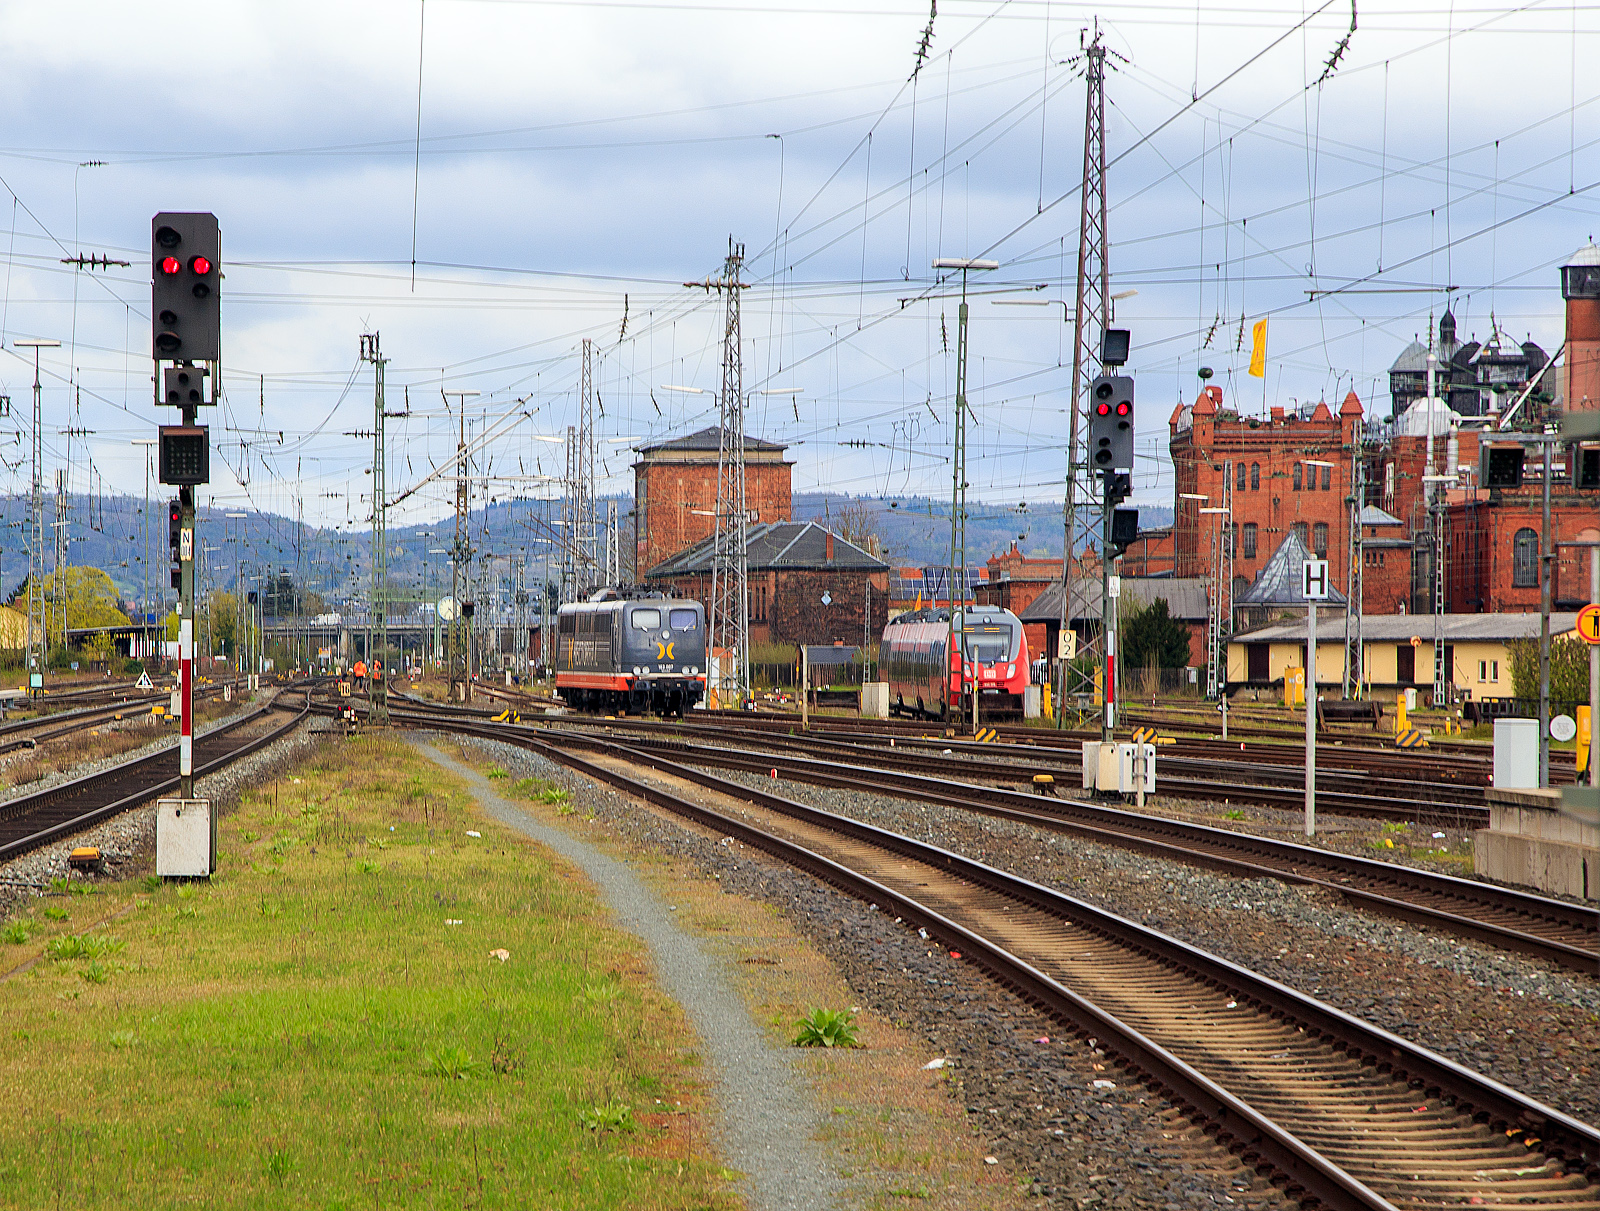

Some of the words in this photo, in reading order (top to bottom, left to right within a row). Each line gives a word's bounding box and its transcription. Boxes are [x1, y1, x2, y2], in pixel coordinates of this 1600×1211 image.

[183, 532, 190, 543] N
[1306, 564, 1325, 594] H
[1063, 631, 1072, 643] 0
[1063, 645, 1071, 656] 2
